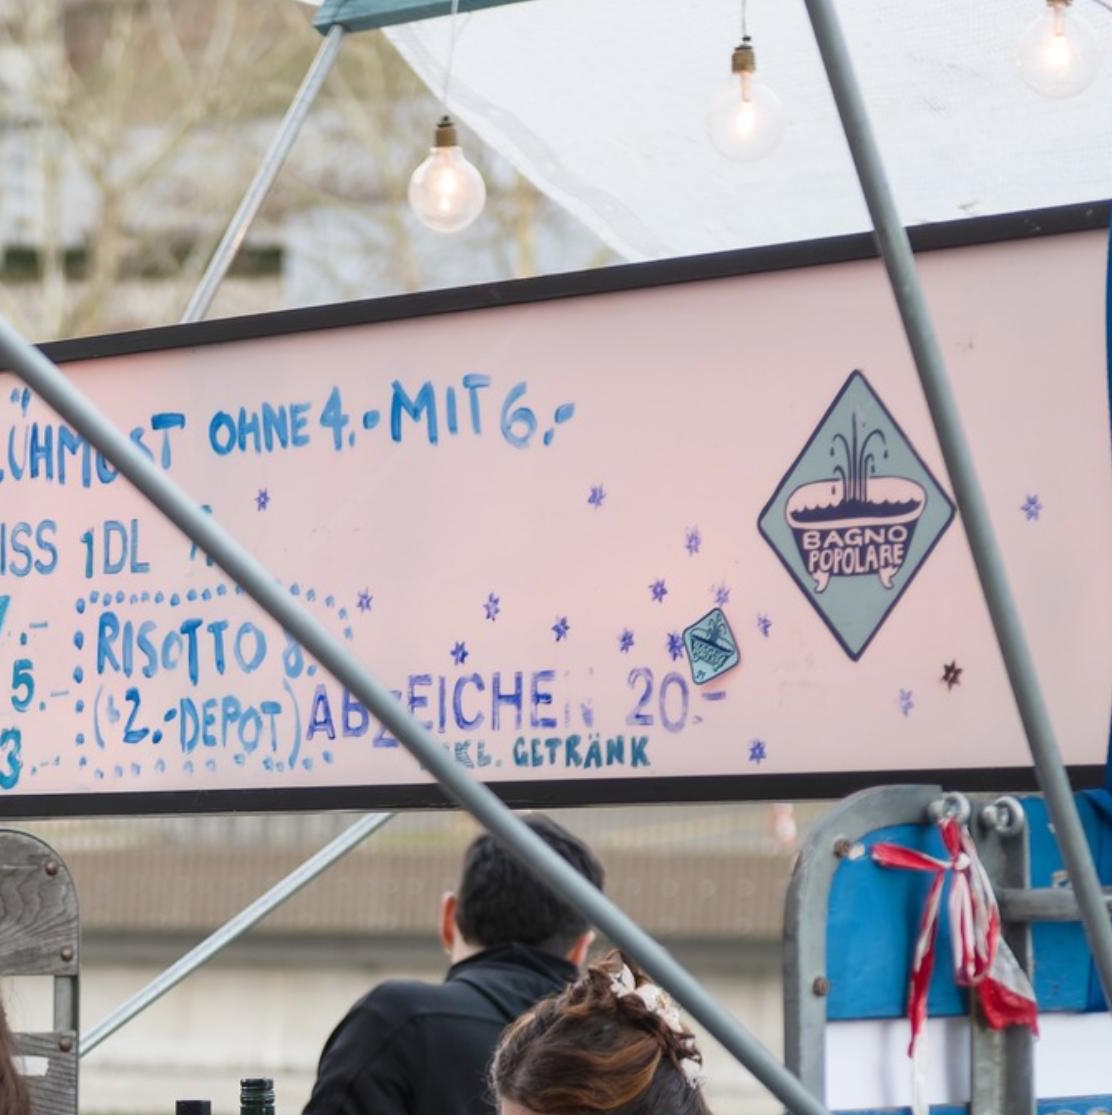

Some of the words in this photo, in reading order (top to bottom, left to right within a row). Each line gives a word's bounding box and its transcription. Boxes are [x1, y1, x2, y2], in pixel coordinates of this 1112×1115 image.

[209, 401, 311, 456] OHNE
[390, 373, 491, 446] MIT
[802, 526, 908, 550] BAGNO
[808, 544, 904, 574] POPOLARE
[96, 611, 267, 686] RISOTTO
[513, 733, 651, 770] GETRÄNK
